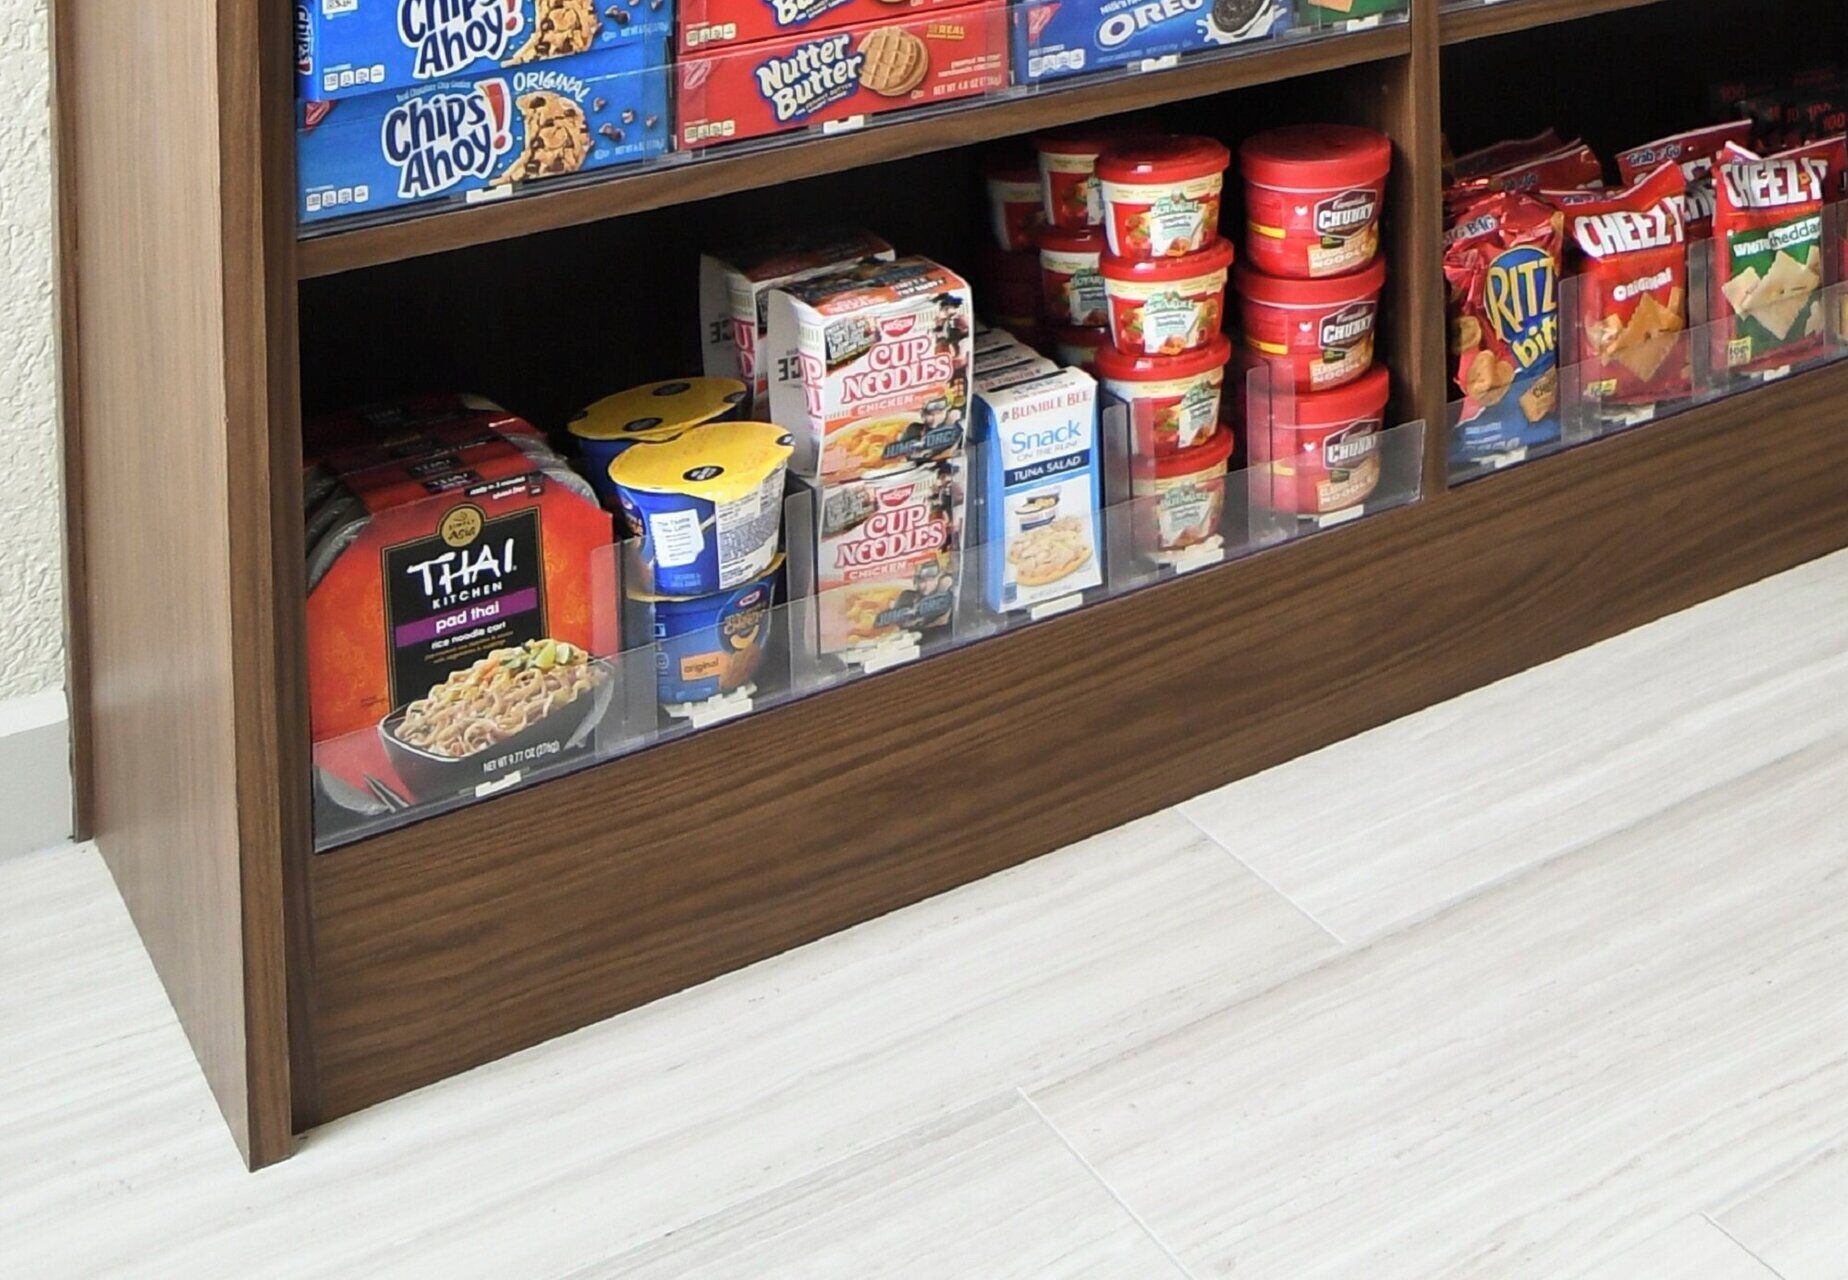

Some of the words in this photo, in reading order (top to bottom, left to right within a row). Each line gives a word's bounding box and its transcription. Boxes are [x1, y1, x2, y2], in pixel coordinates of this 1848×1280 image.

[756, 35, 850, 97] Nutter
[514, 71, 590, 101] ORIGINAL
[772, 54, 862, 121] Butter
[1318, 203, 1374, 229] CHUNKY
[1575, 205, 1672, 258] CHEEZ
[1487, 260, 1558, 335] RITZ
[869, 335, 932, 369] CUP
[840, 354, 955, 404] NOODLES
[857, 394, 915, 417] CHICKEN
[1010, 397, 1063, 421] BUMBLE
[1066, 390, 1091, 408] BEE
[1010, 420, 1082, 455] Snack
[1013, 464, 1044, 483] TUNA
[1046, 456, 1082, 474] SALAD
[863, 505, 927, 539] CUP
[835, 520, 949, 569] NOODLES
[407, 537, 515, 597] THAI
[849, 561, 908, 581] CHICKEN
[432, 581, 503, 610] KITCHEN
[435, 611, 468, 634] pad
[471, 600, 500, 622] thai
[431, 639, 449, 650] rice
[682, 655, 719, 676] original
